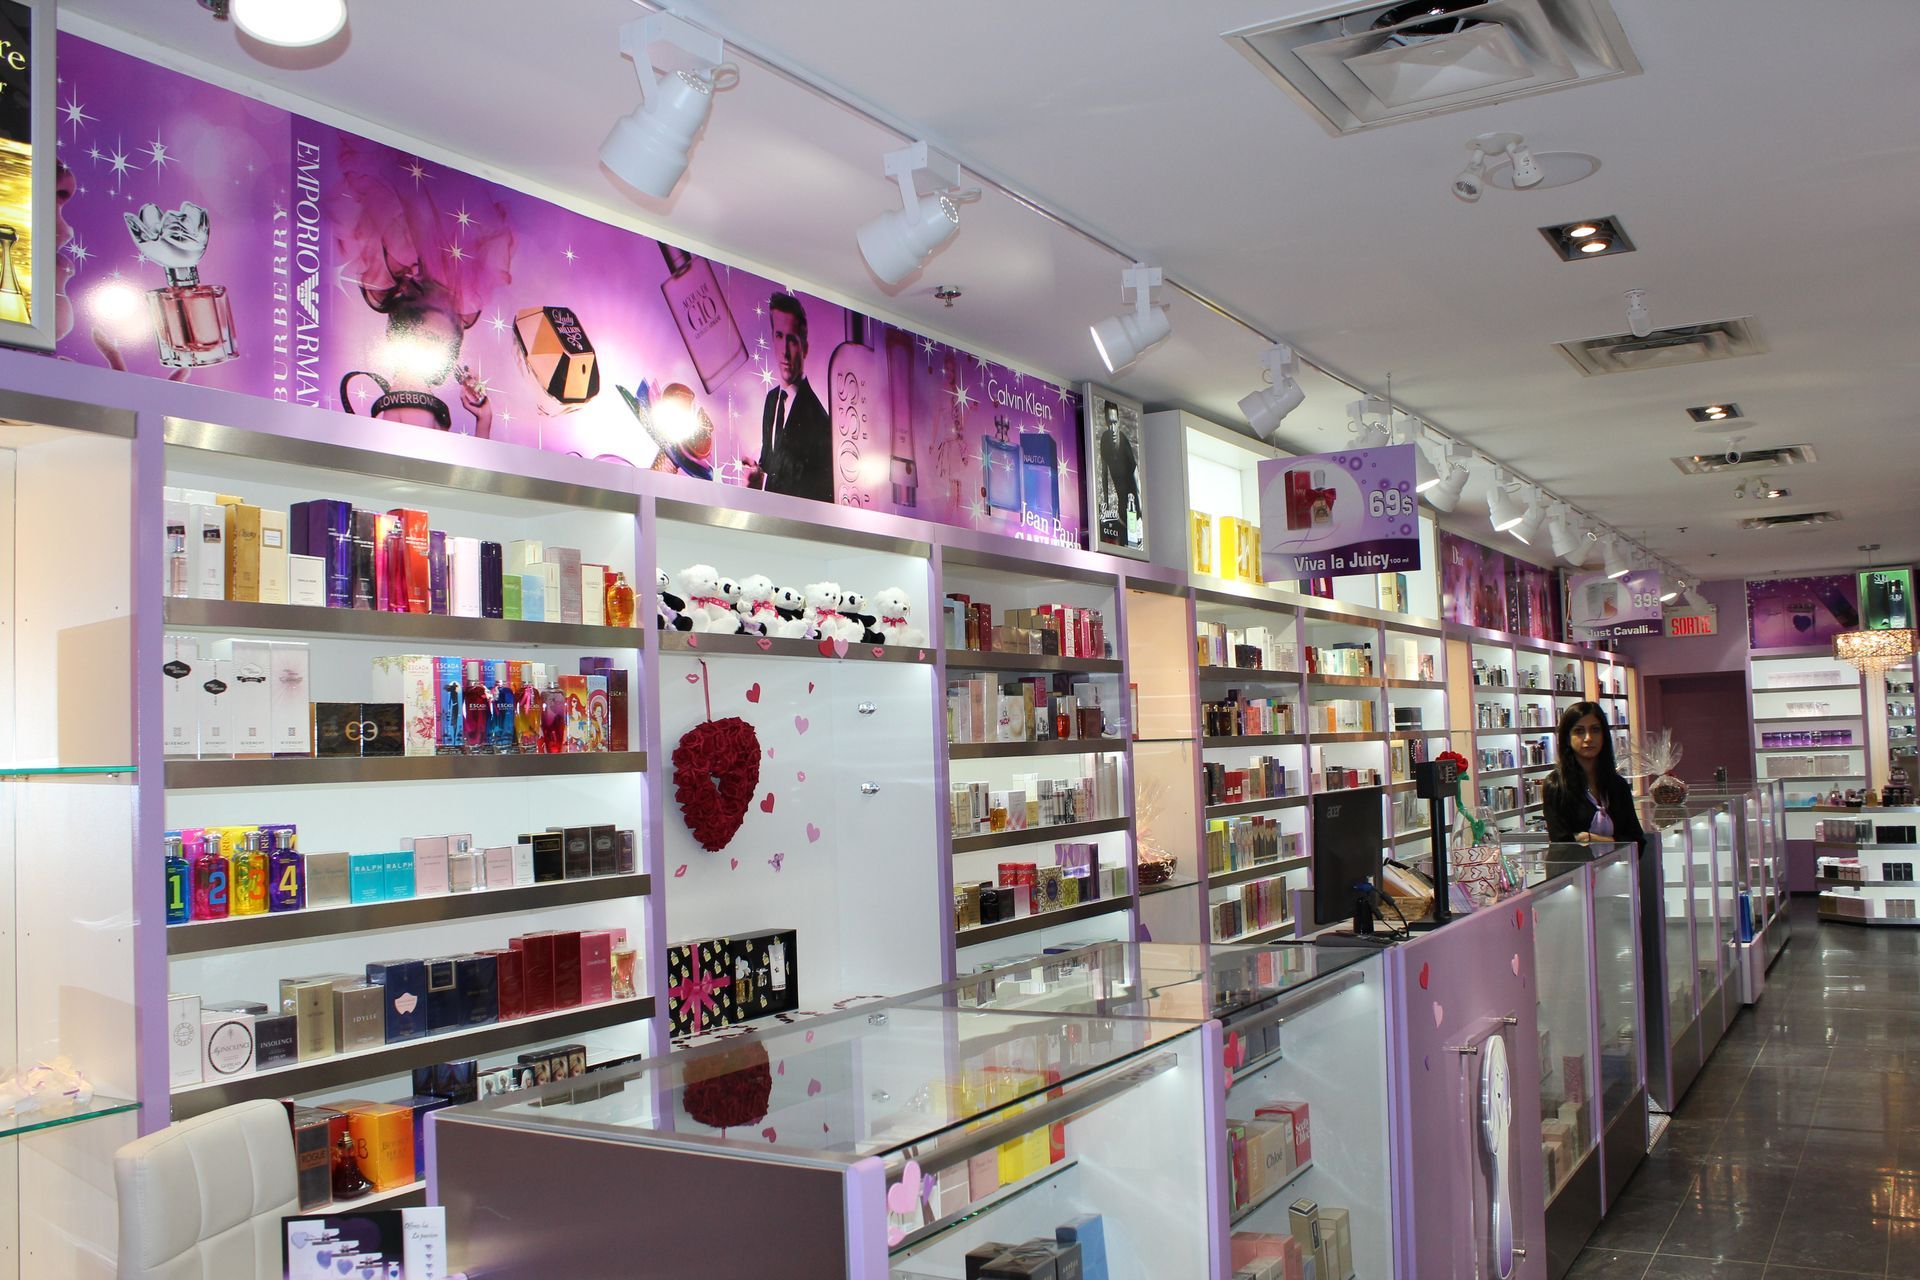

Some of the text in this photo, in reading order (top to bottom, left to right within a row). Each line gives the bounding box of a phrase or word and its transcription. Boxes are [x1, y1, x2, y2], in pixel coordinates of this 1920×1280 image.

[297, 139, 320, 273] EMPORIO
[273, 205, 288, 402] BURBERRY
[687, 296, 717, 331] GIO
[988, 379, 1051, 420] Calvin Klein
[1023, 453, 1045, 464] NAUTICA
[1369, 488, 1413, 519] 69$
[1021, 500, 1049, 536] Jean
[1053, 517, 1079, 546] Paul
[1293, 556, 1327, 573] Viva
[1330, 554, 1345, 570] la
[1349, 551, 1390, 570] Juicy
[1452, 545, 1464, 567] Dior
[1613, 624, 1648, 636] Cavalli
[1671, 615, 1713, 636] SORTIE
[278, 865, 298, 897] 4
[354, 864, 383, 872] RALPH
[168, 875, 184, 909] 1
[208, 871, 227, 905] 2
[249, 869, 266, 900] 3
[220, 1041, 250, 1053] INSOLENCE
[260, 1037, 293, 1049] INSOLENCE
